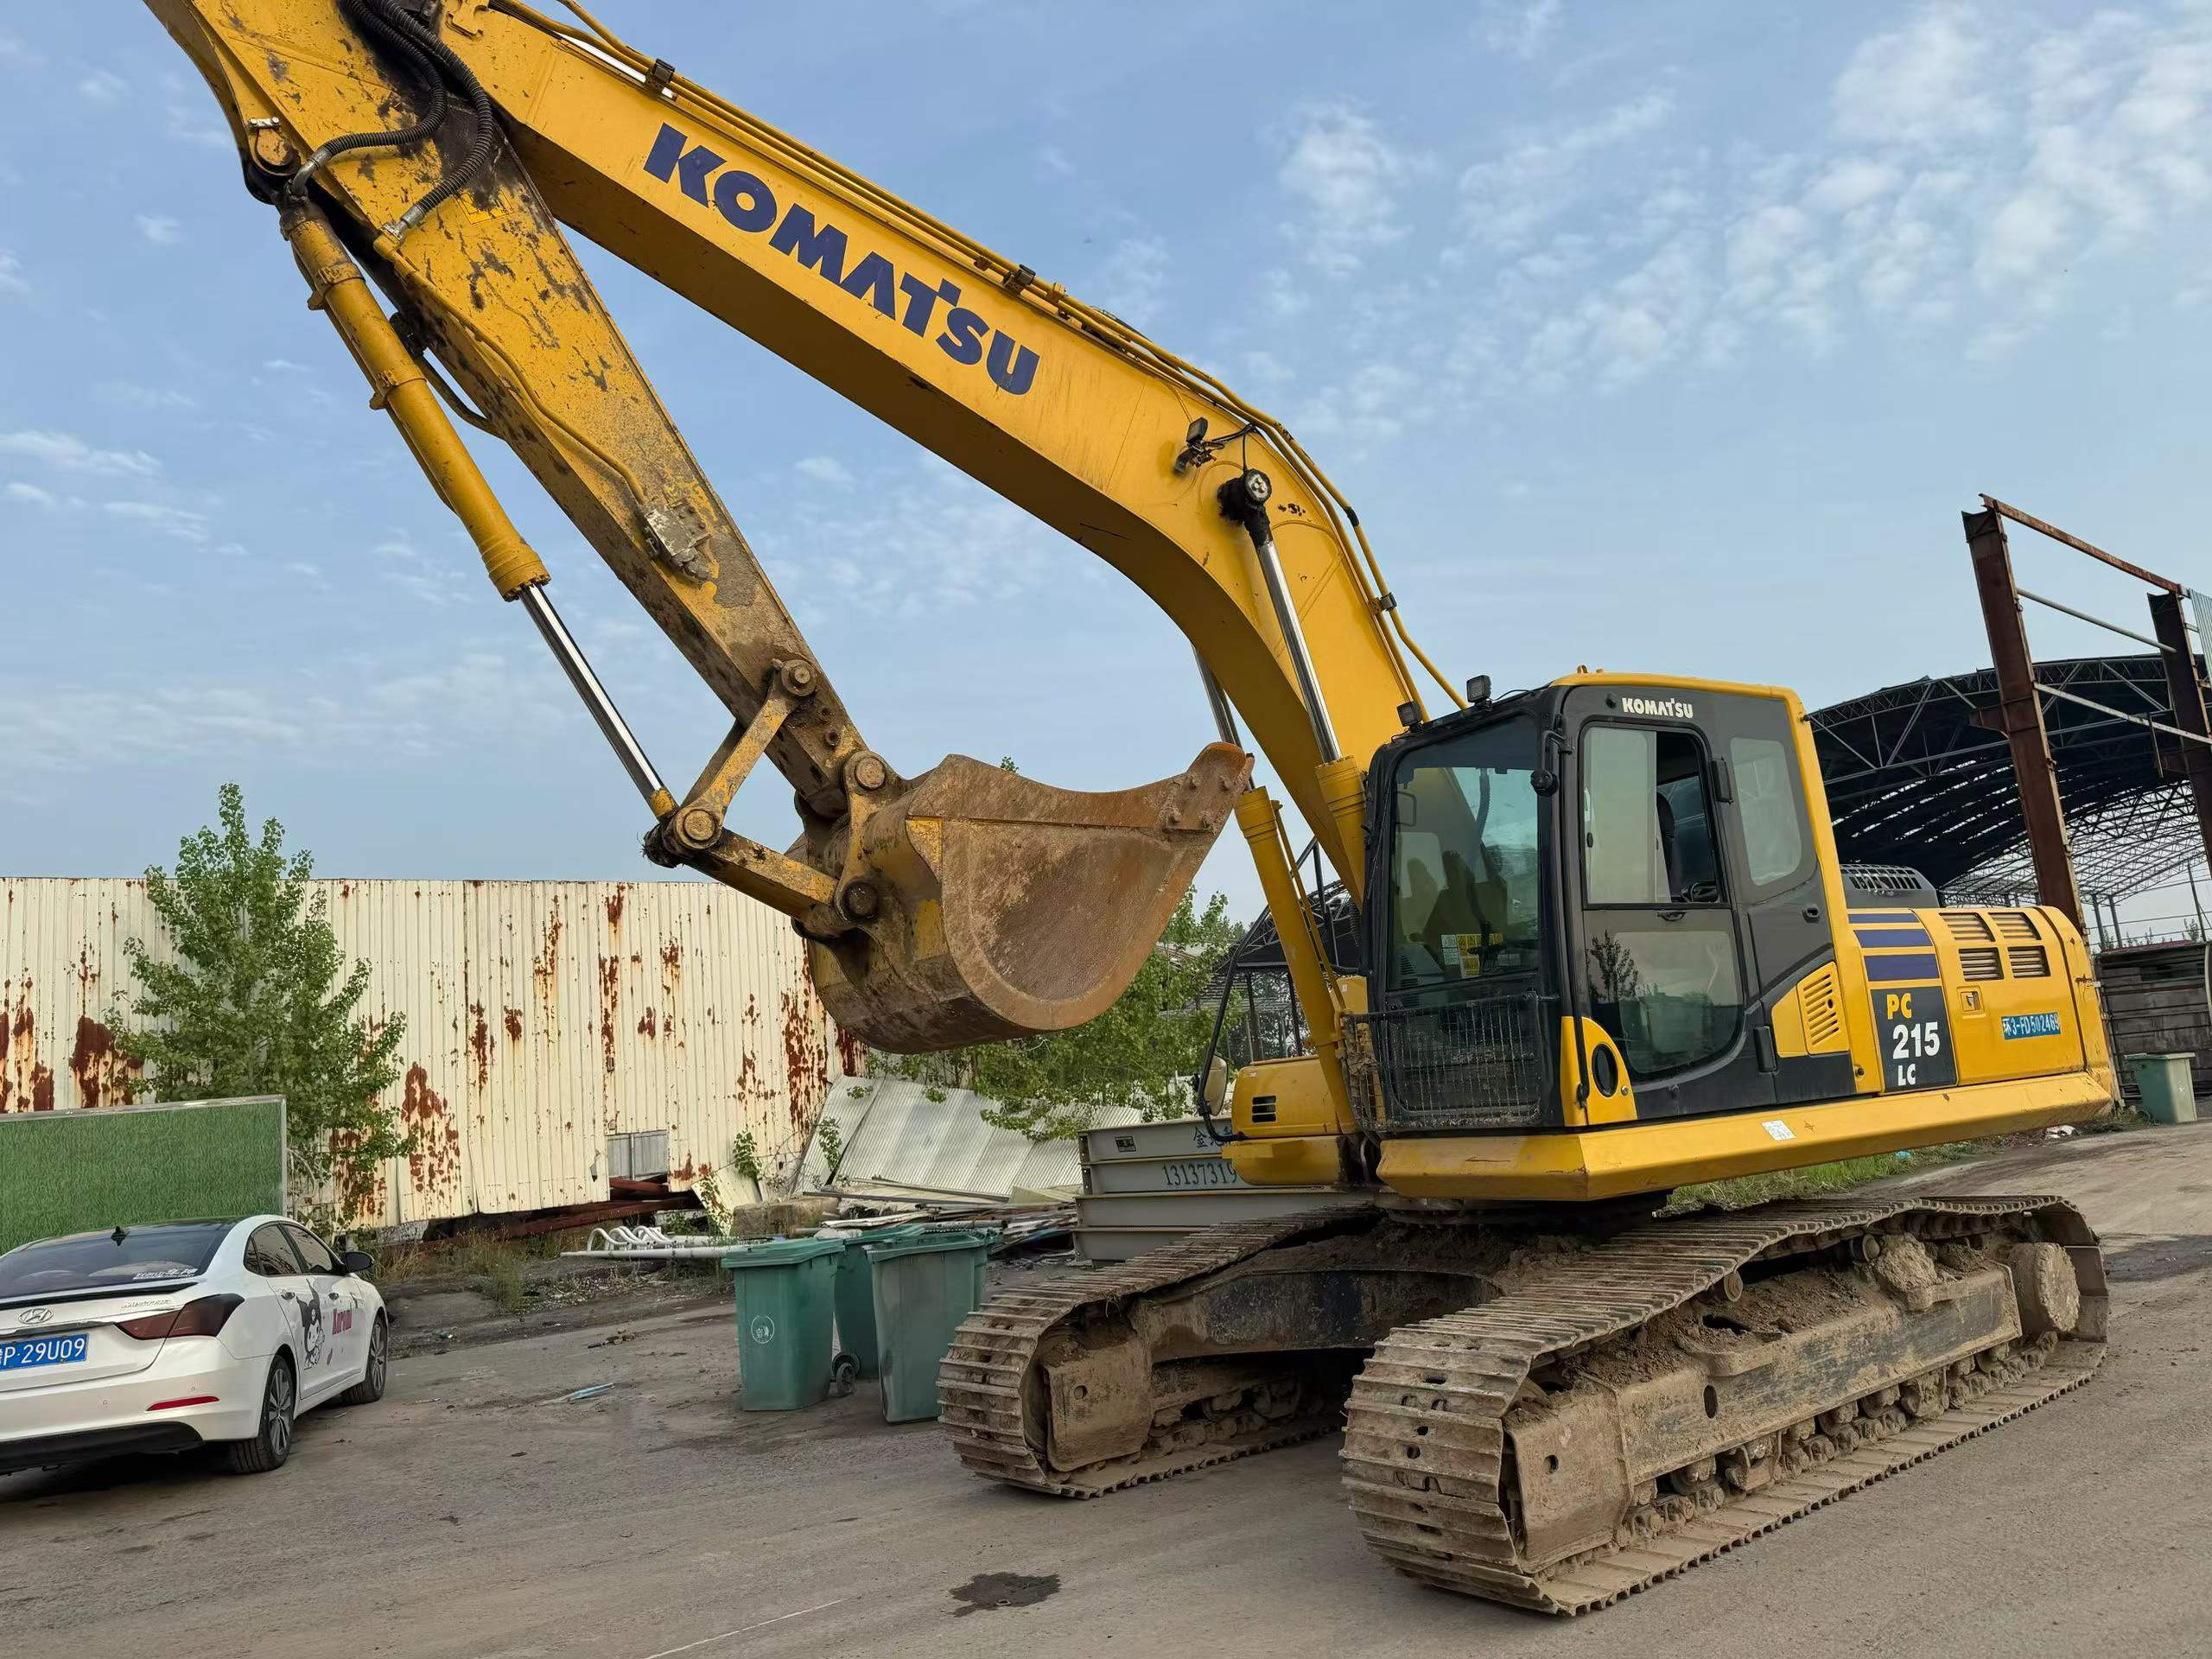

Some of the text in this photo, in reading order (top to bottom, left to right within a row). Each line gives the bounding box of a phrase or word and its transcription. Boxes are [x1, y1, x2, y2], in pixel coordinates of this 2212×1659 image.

[643, 122, 1040, 396] KOMATSU
[1621, 697, 1694, 719] KOMATSU
[1886, 992, 1912, 1020] PC
[1892, 1021, 1941, 1059] 215
[1897, 1063, 1916, 1086] LC
[0, 1338, 85, 1366] P·29U09
